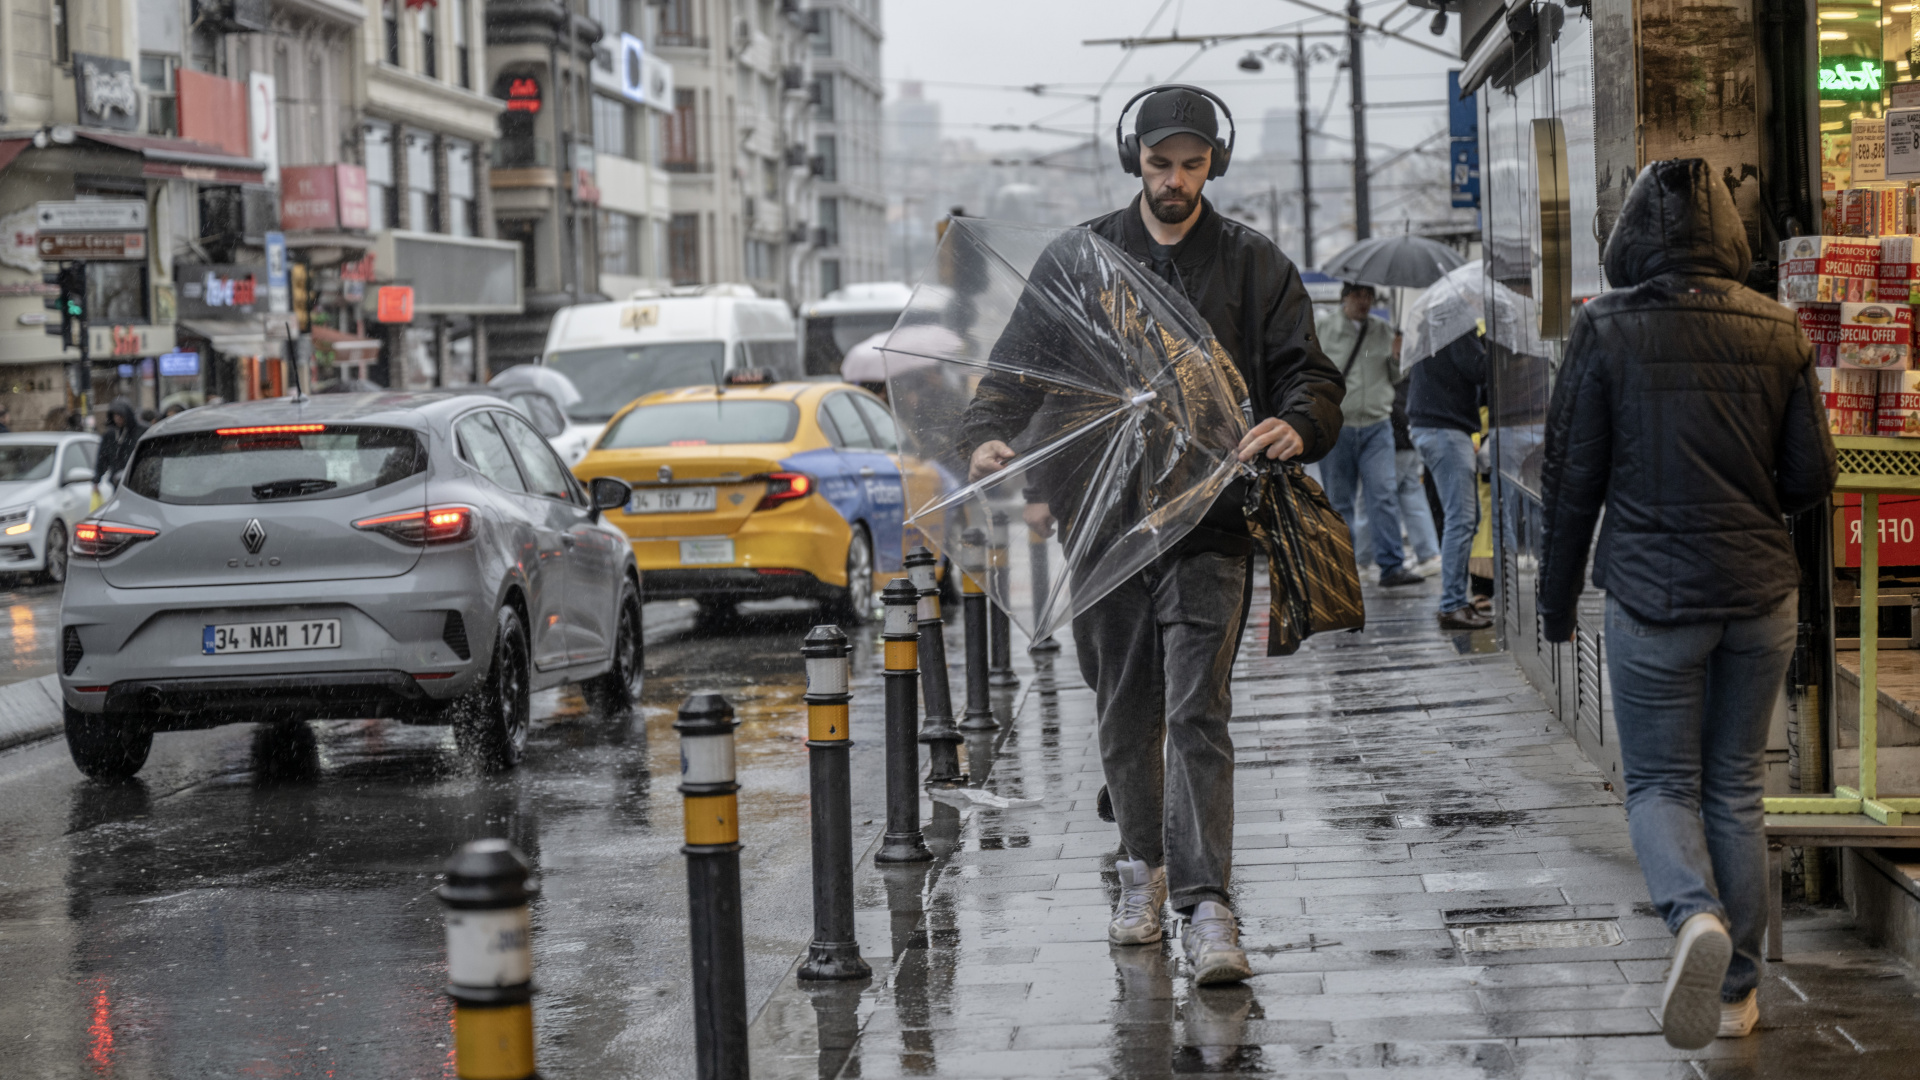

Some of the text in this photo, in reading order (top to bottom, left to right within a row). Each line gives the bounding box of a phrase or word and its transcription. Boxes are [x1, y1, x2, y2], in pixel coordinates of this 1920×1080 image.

[1171, 97, 1196, 122] NY
[1825, 260, 1875, 277] SPECIAL OFFER
[1840, 328, 1897, 342] SPECIAL OFFER
[1837, 395, 1858, 409] SPECIAL
[1859, 396, 1875, 410] OFFER
[692, 491, 709, 506] 77
[227, 557, 282, 569] CLIO
[215, 622, 336, 650] 34 NAM 171
